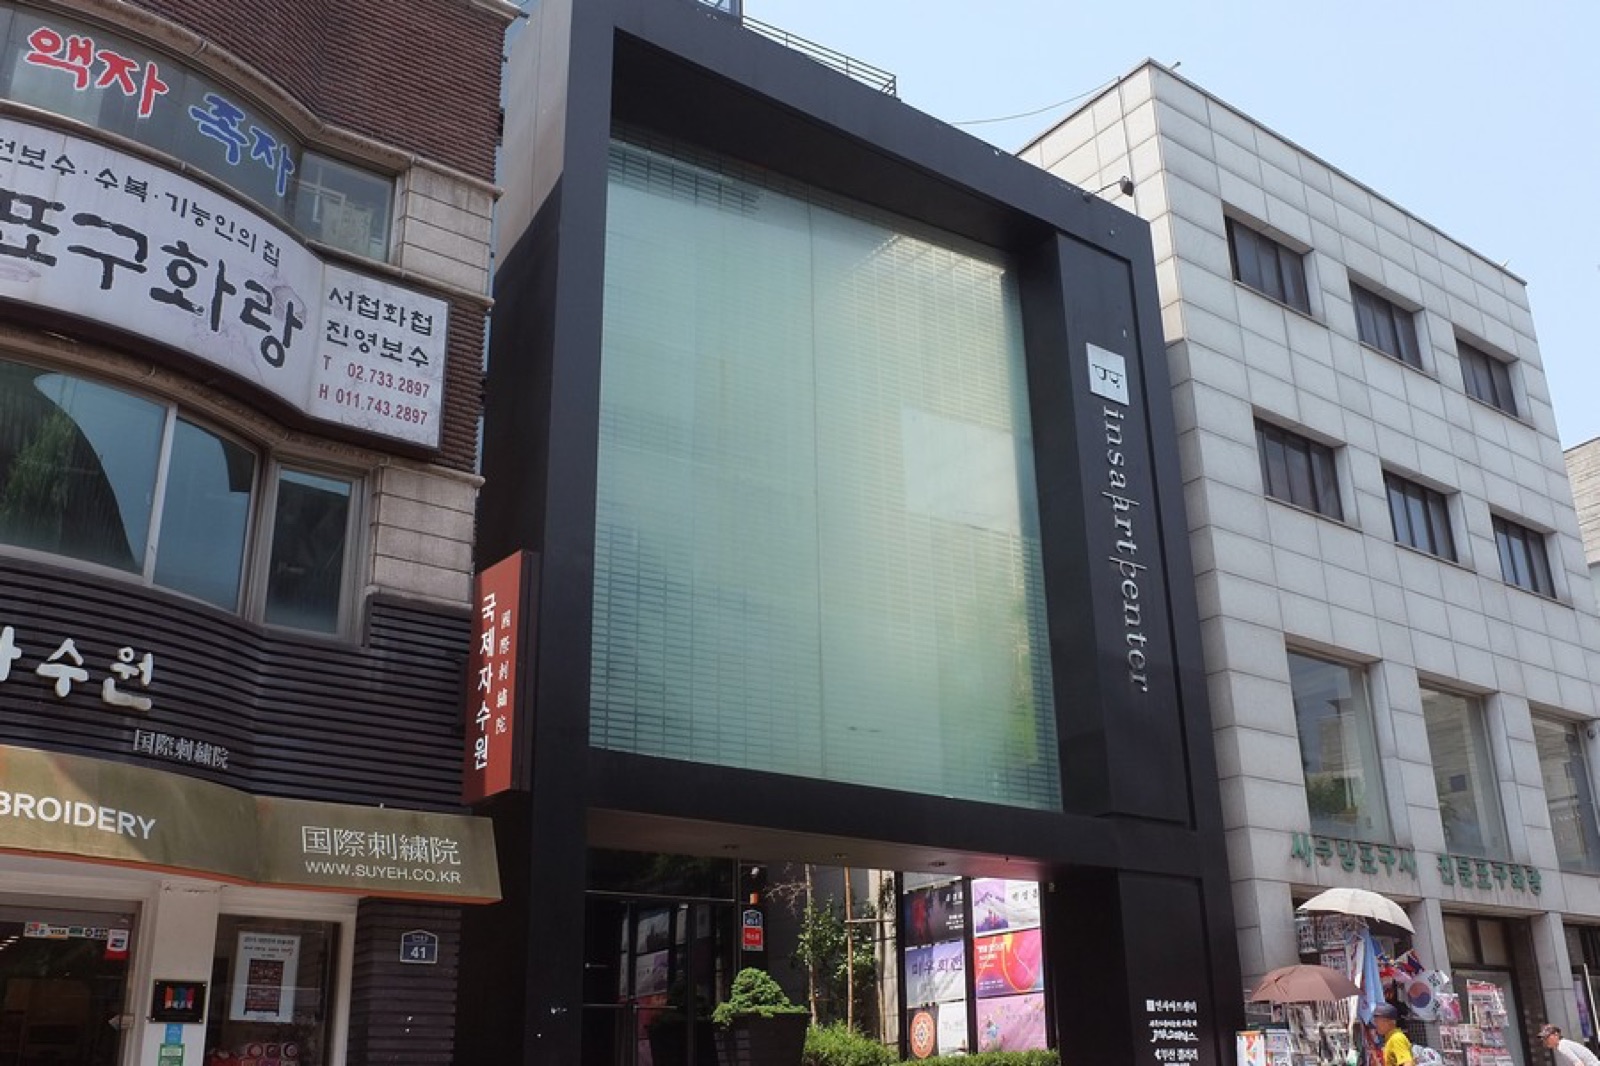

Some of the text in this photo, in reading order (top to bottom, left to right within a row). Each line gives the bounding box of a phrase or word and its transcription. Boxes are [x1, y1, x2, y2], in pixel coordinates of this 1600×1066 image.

[26, 26, 169, 119] 액자
[188, 92, 296, 196] 족자
[262, 239, 281, 268] 집
[328, 287, 433, 337] 서첩화첩
[326, 320, 430, 368] 진영보수
[324, 354, 430, 398] T 02.733.2897
[319, 384, 428, 426] H 011.743.2897
[474, 592, 497, 770] 국제자수원
[0, 791, 156, 840] BROIDERY
[305, 861, 462, 884] WWW.SUYEH.CO.KR
[410, 946, 426, 959] 41
